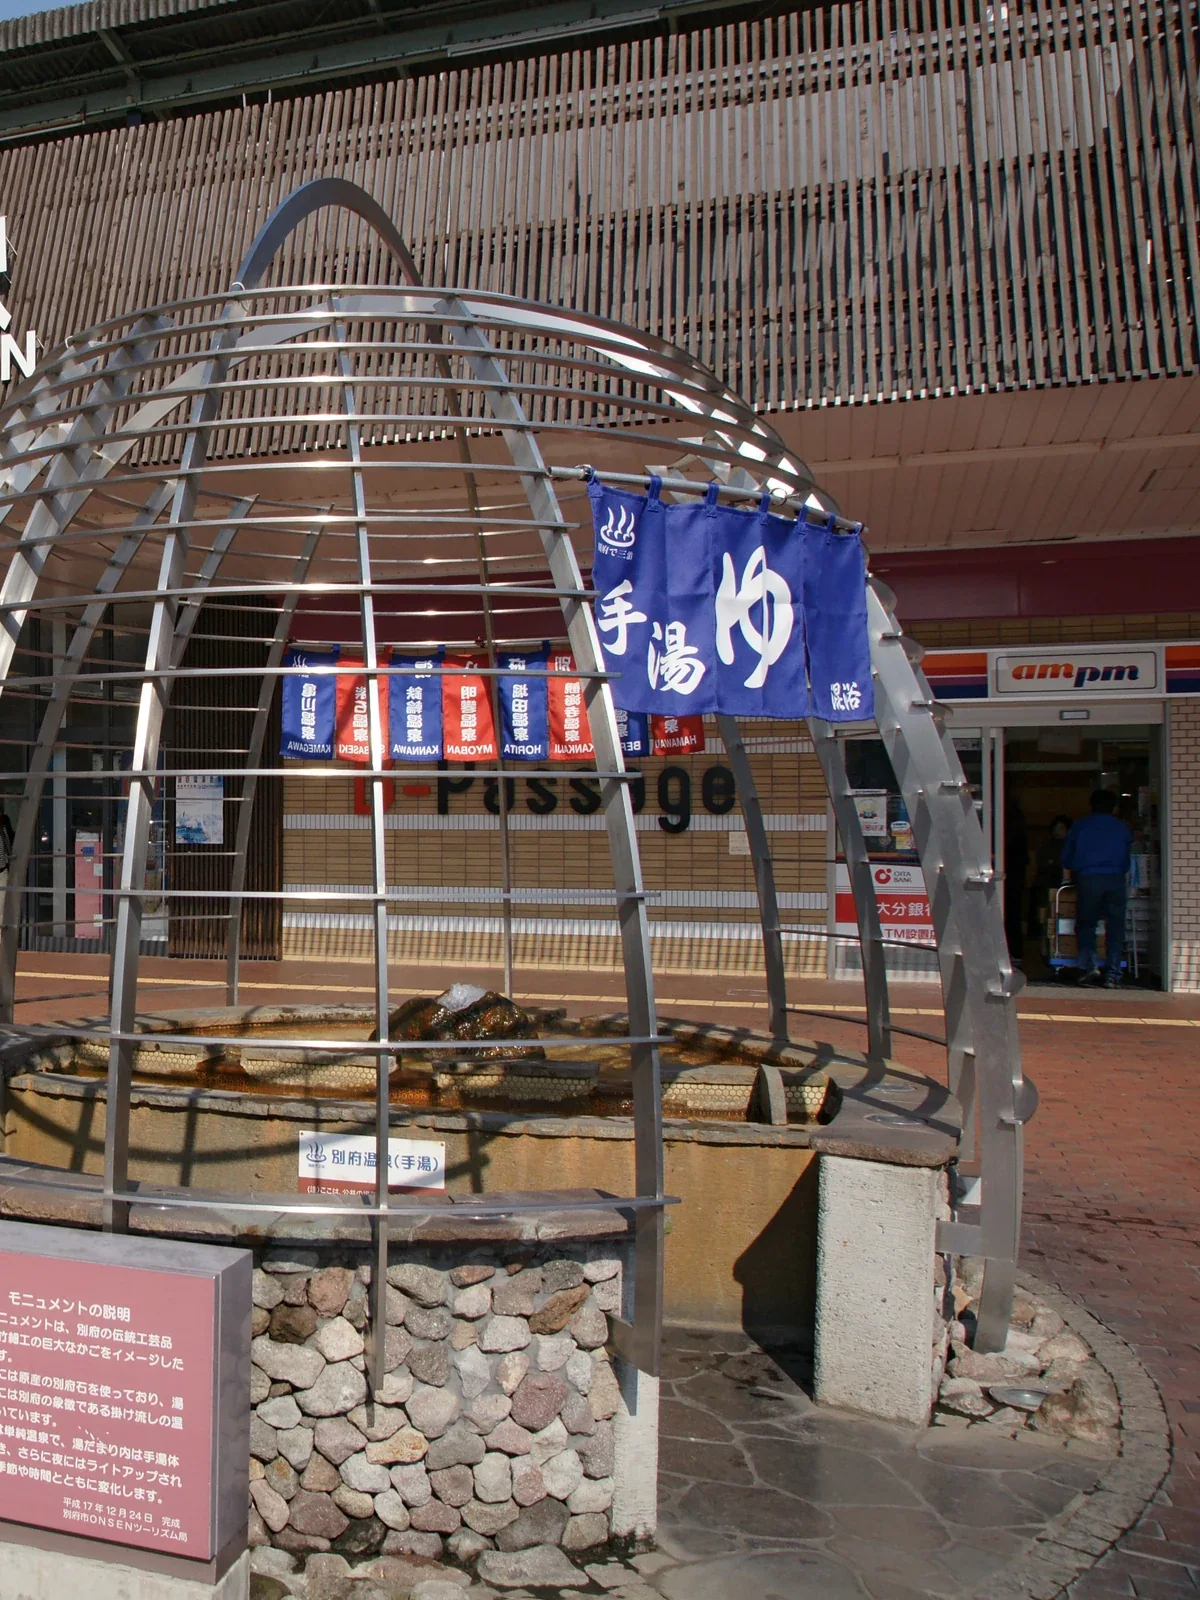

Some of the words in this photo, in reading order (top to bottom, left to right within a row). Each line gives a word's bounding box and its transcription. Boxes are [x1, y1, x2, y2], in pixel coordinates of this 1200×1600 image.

[597, 579, 706, 695] 手湯
[714, 545, 794, 688] ゆ
[830, 682, 861, 711] 混浴
[8, 1291, 131, 1322] モニュメントの説明
